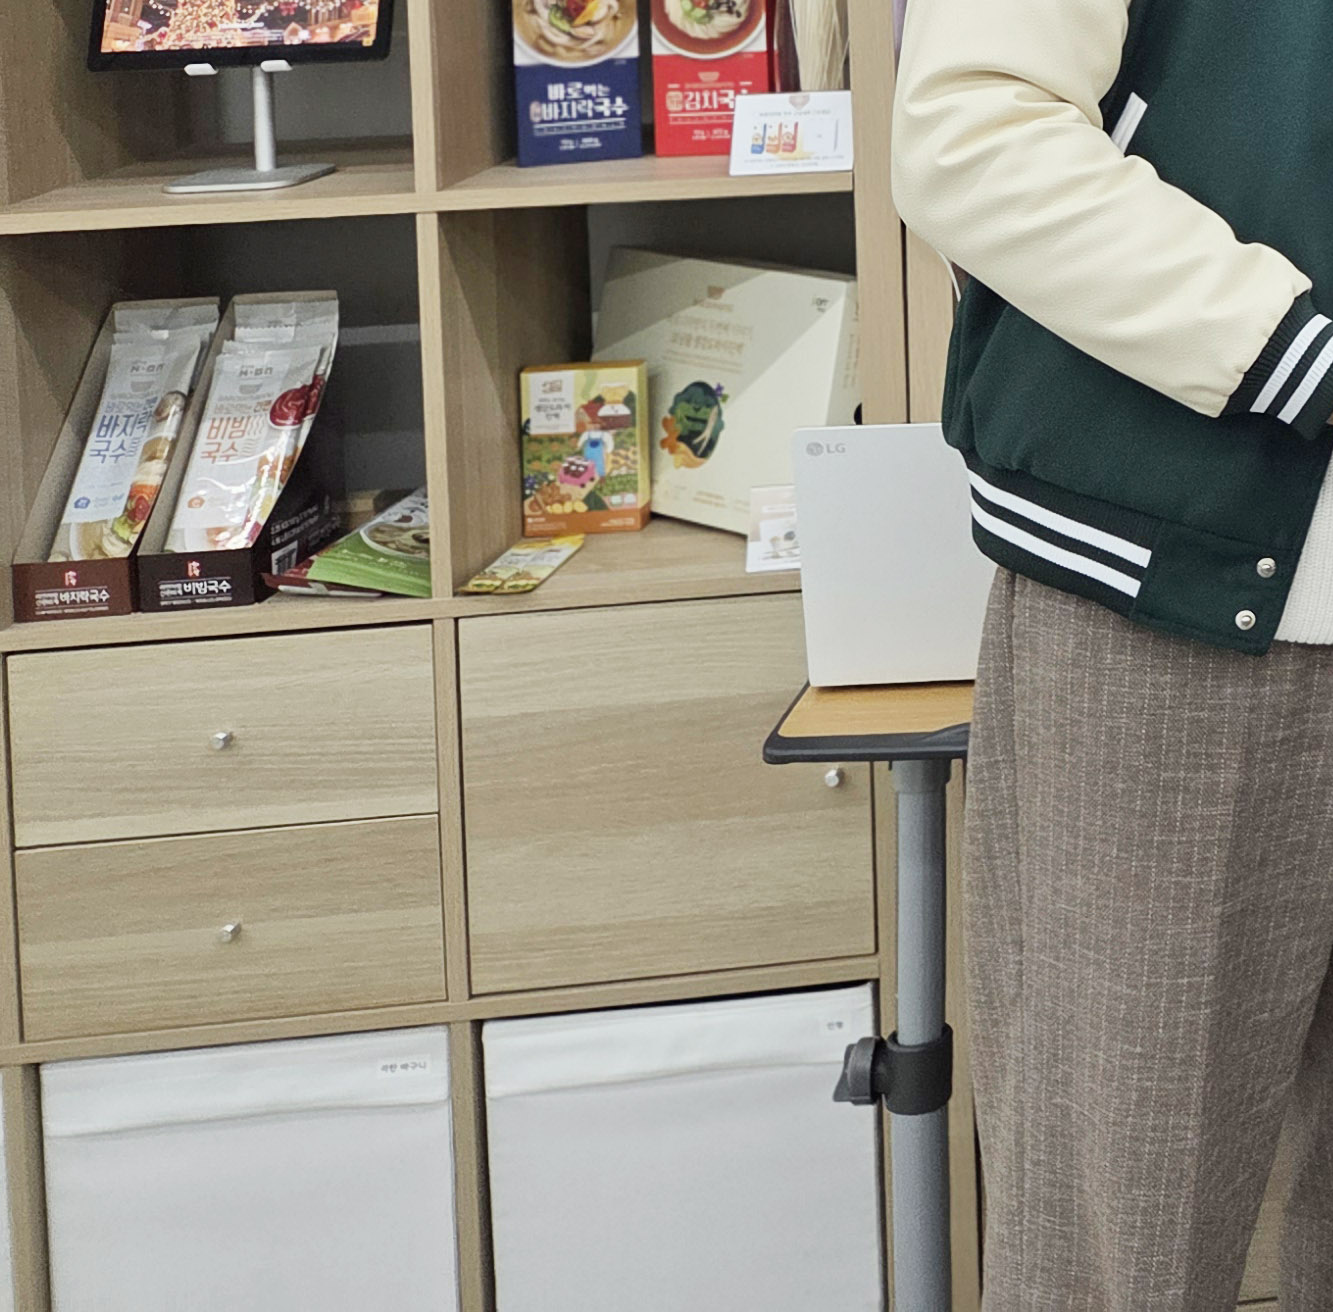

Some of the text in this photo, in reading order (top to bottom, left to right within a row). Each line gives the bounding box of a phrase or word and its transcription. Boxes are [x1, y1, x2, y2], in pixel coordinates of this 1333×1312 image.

[684, 88, 749, 111] 김치국
[207, 416, 251, 440] 비빔
[89, 439, 128, 464] 국수
[201, 440, 239, 465] 국수
[826, 443, 846, 454] LG
